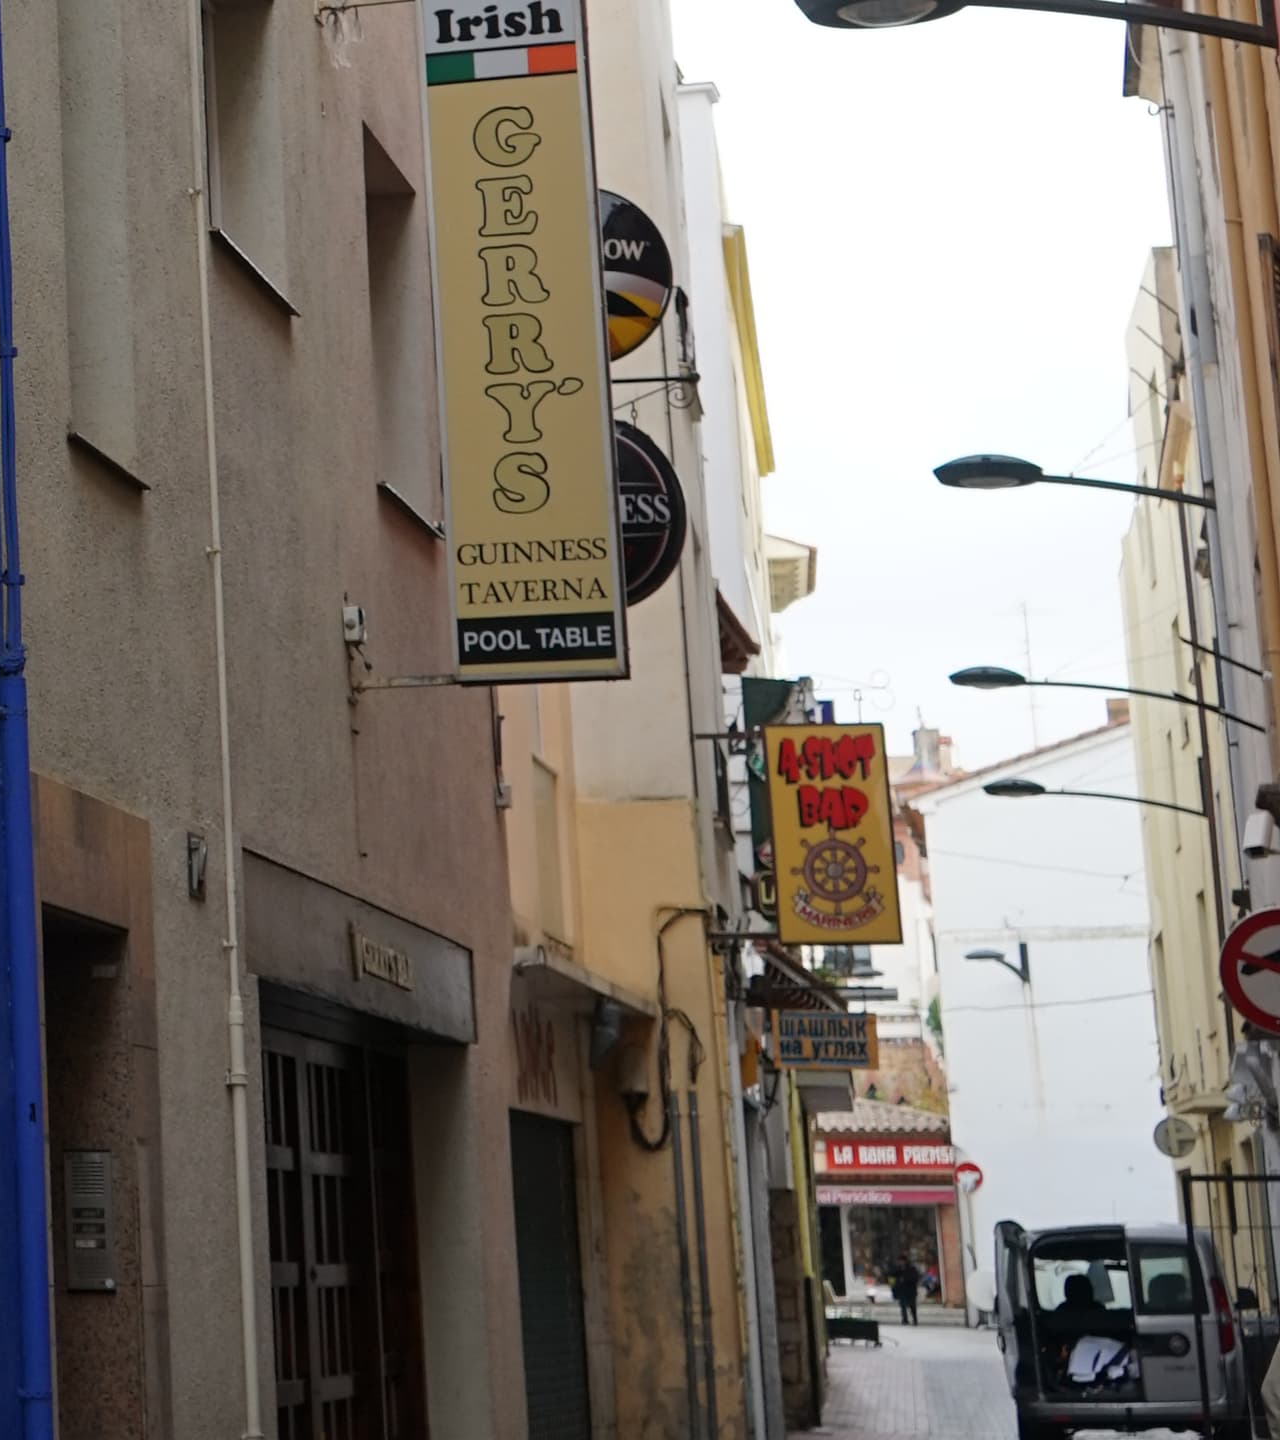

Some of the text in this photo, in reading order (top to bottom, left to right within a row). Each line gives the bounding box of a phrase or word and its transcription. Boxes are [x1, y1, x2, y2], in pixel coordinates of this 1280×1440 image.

[434, 0, 564, 43] Irish
[473, 106, 583, 515] GERRY'S
[457, 537, 607, 566] GUINNESS
[460, 577, 608, 605] TAVERNA
[463, 625, 612, 652] POOL TABLE
[798, 784, 870, 830] BAR
[780, 1018, 867, 1037] ШАШЛЫК
[780, 1041, 802, 1055] на
[833, 1146, 853, 1165] LA
[858, 1146, 897, 1165] BONA
